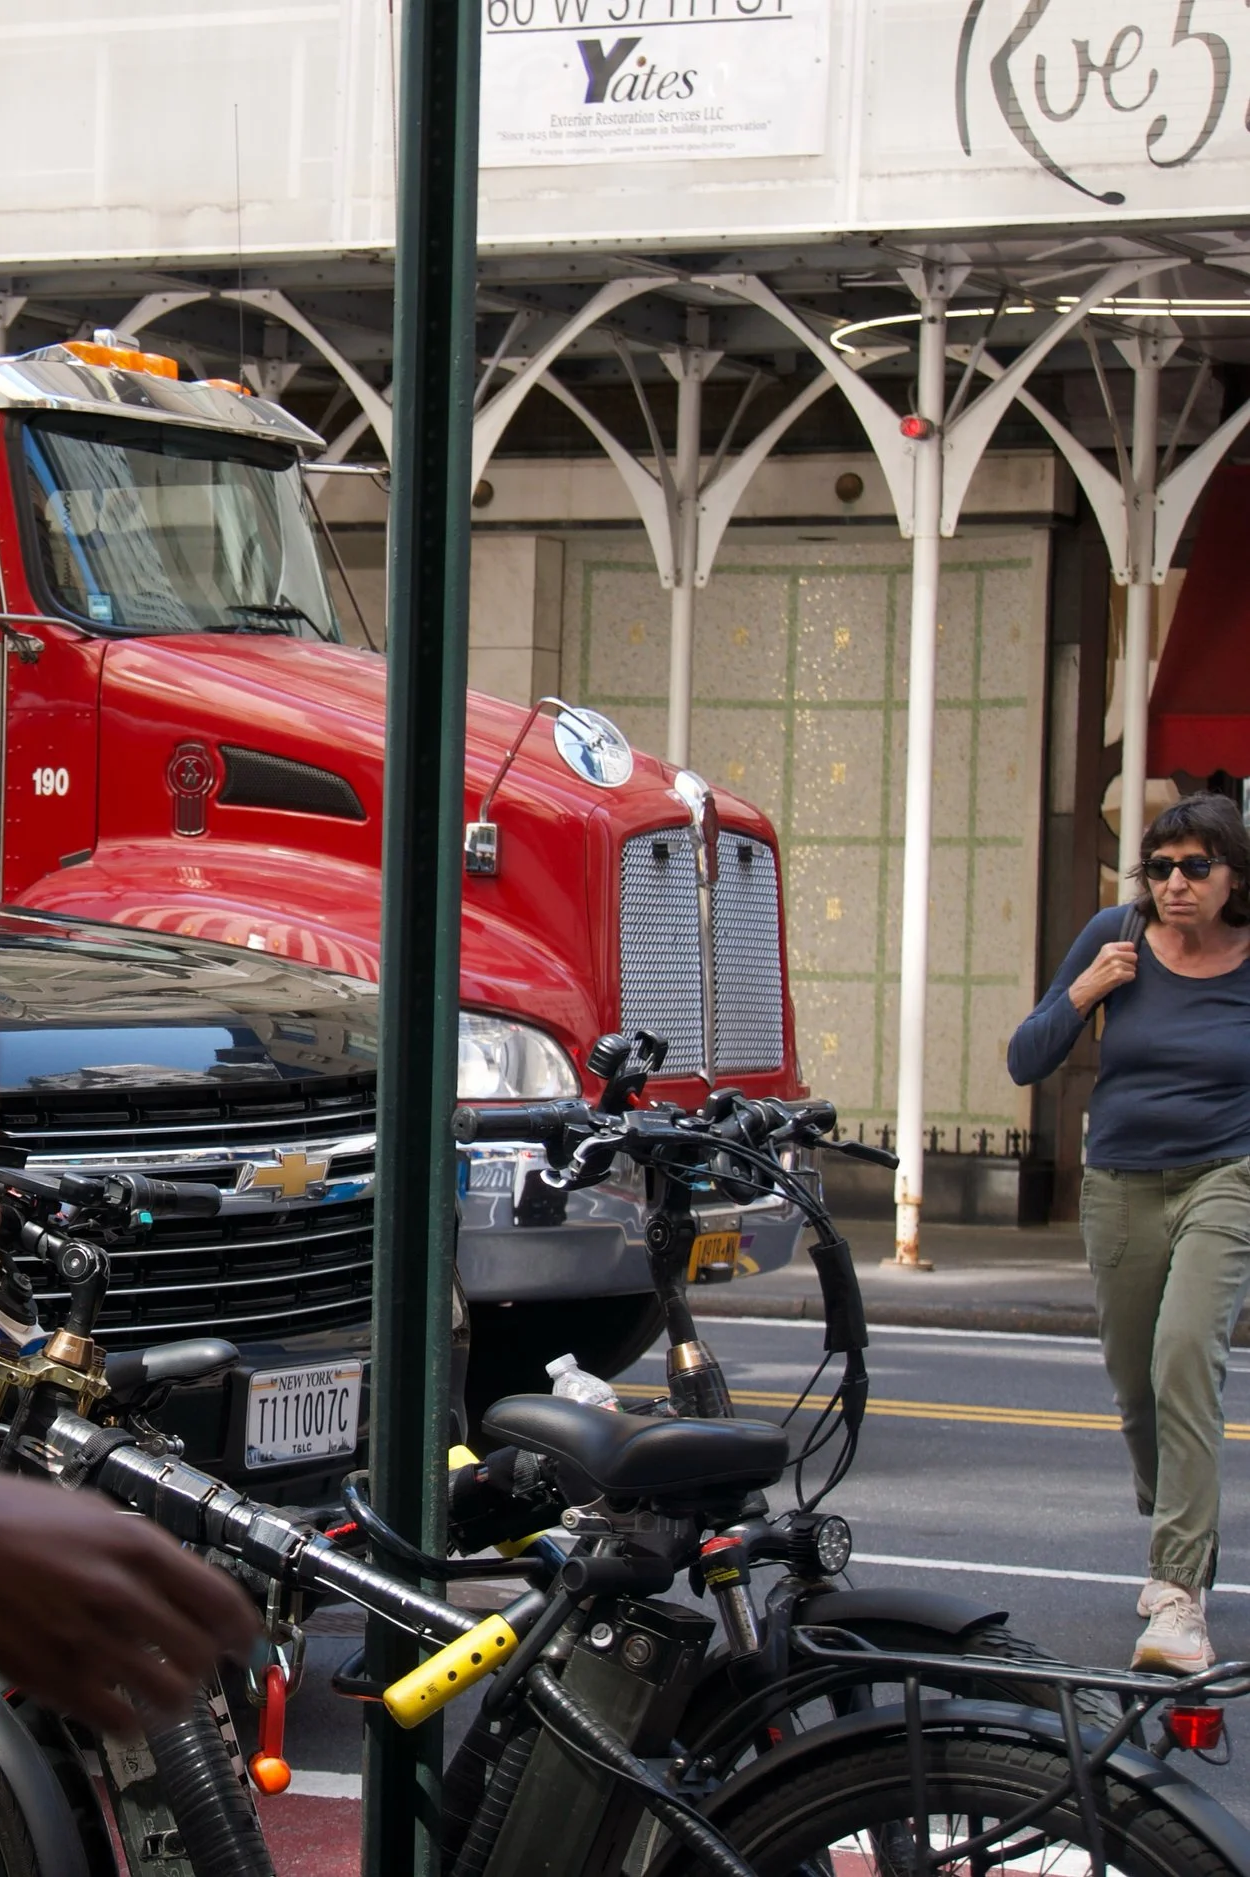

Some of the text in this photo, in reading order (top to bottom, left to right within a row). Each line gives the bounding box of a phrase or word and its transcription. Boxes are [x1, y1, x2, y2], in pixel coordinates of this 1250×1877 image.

[488, 0, 534, 27] 60
[577, 37, 698, 103] Yates
[550, 106, 725, 128] Exterior Restoration Services LLC
[32, 767, 69, 796] 190
[278, 1370, 333, 1391] NEW YORK
[258, 1387, 349, 1444] T111007C
